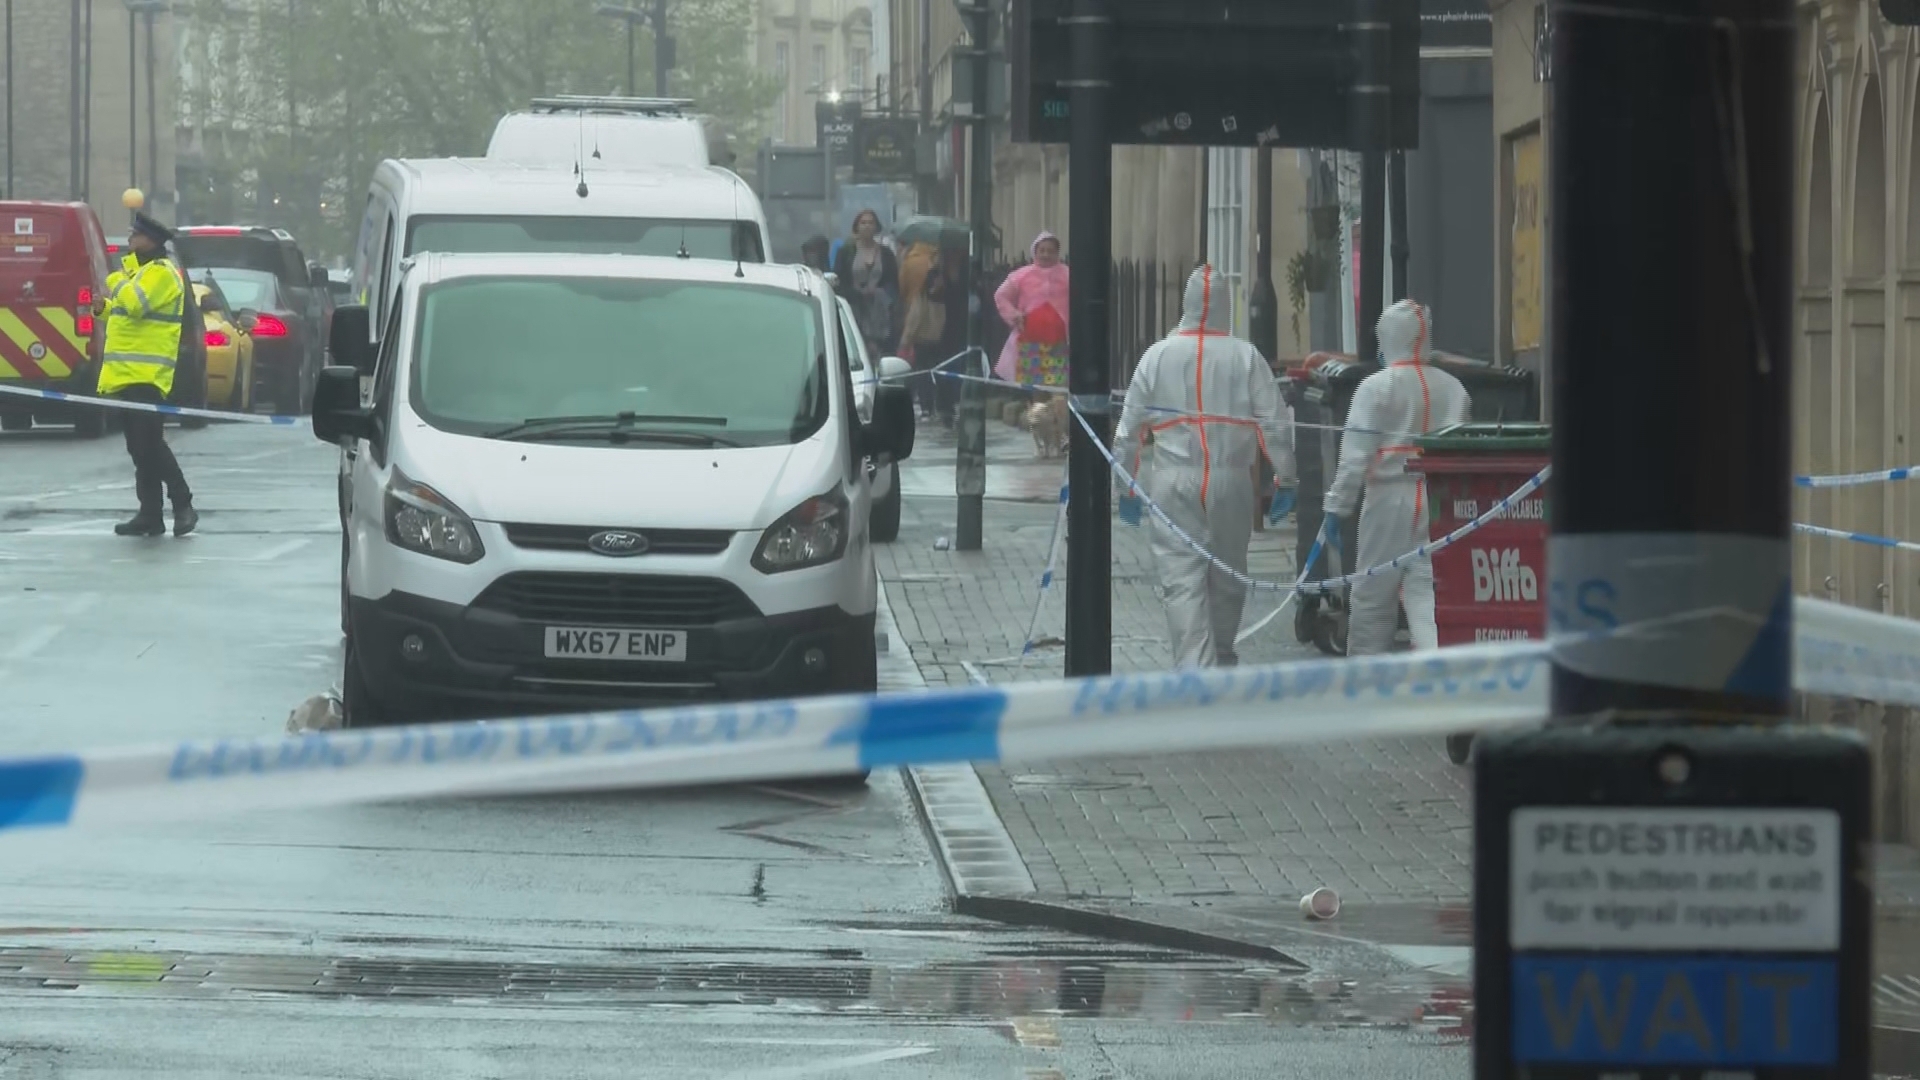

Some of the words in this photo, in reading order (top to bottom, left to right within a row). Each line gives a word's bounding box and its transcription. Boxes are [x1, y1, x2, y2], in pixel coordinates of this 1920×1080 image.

[824, 124, 853, 132] BLACK
[830, 136, 848, 145] FOX
[1453, 500, 1477, 518] MIXED
[602, 533, 635, 548] Ford
[1471, 548, 1537, 601] Biffa
[556, 630, 621, 655] WX67
[628, 632, 676, 656] ENP
[1534, 822, 1817, 856] PEDESTRIANS
[1605, 868, 1697, 892] button
[1705, 869, 1758, 892] and
[1542, 900, 1582, 923] for
[1591, 899, 1678, 930] signal
[1535, 968, 1812, 1054] WAIT
